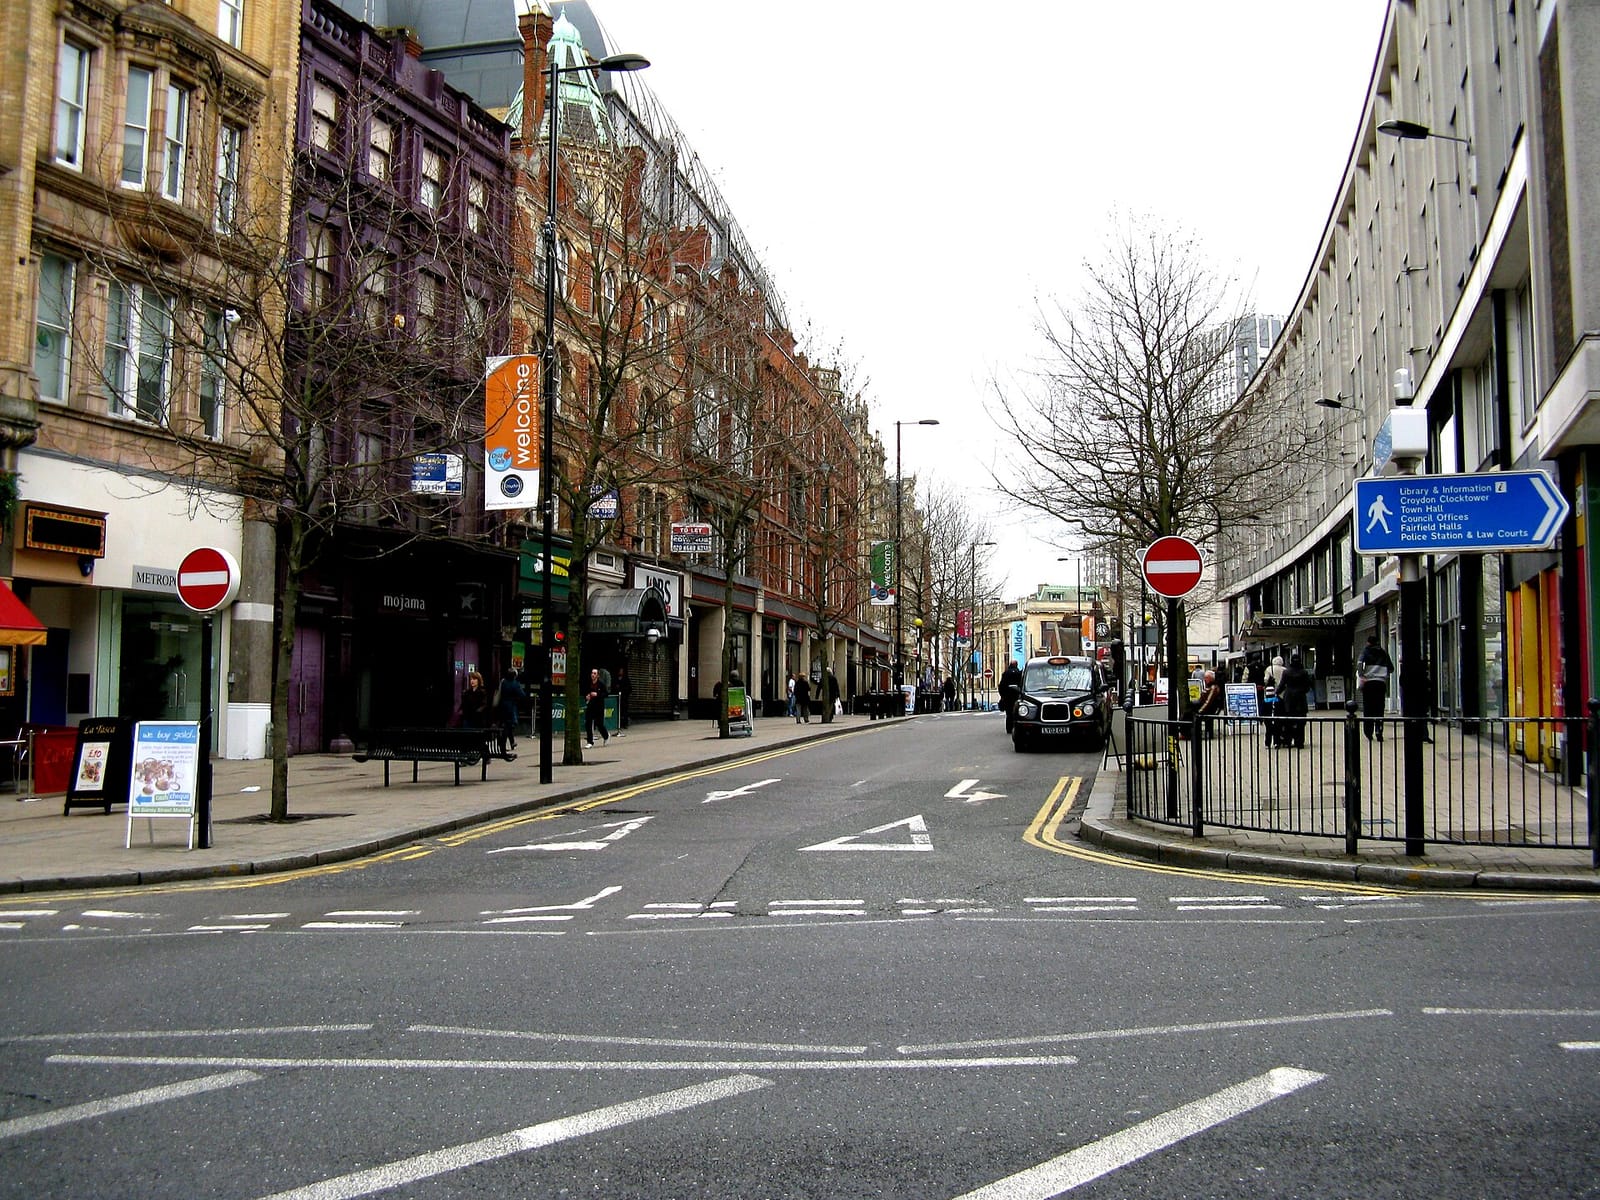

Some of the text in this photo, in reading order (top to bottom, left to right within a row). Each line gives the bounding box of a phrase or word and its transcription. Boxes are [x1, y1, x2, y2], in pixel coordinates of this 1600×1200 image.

[514, 364, 531, 465] welcome
[1400, 484, 1492, 496] Library & Information
[1400, 494, 1489, 506] Croydon Clocktower
[1401, 504, 1443, 513] Town Hall
[1401, 513, 1469, 523] Council Offices
[1401, 522, 1462, 532] Fairfield Halls
[1401, 529, 1529, 541] Police Station & Law Courts
[383, 593, 425, 611] mojama
[1271, 618, 1346, 626] ST GEORGES WALK
[1014, 623, 1024, 653] Allders
[157, 730, 171, 739] buy
